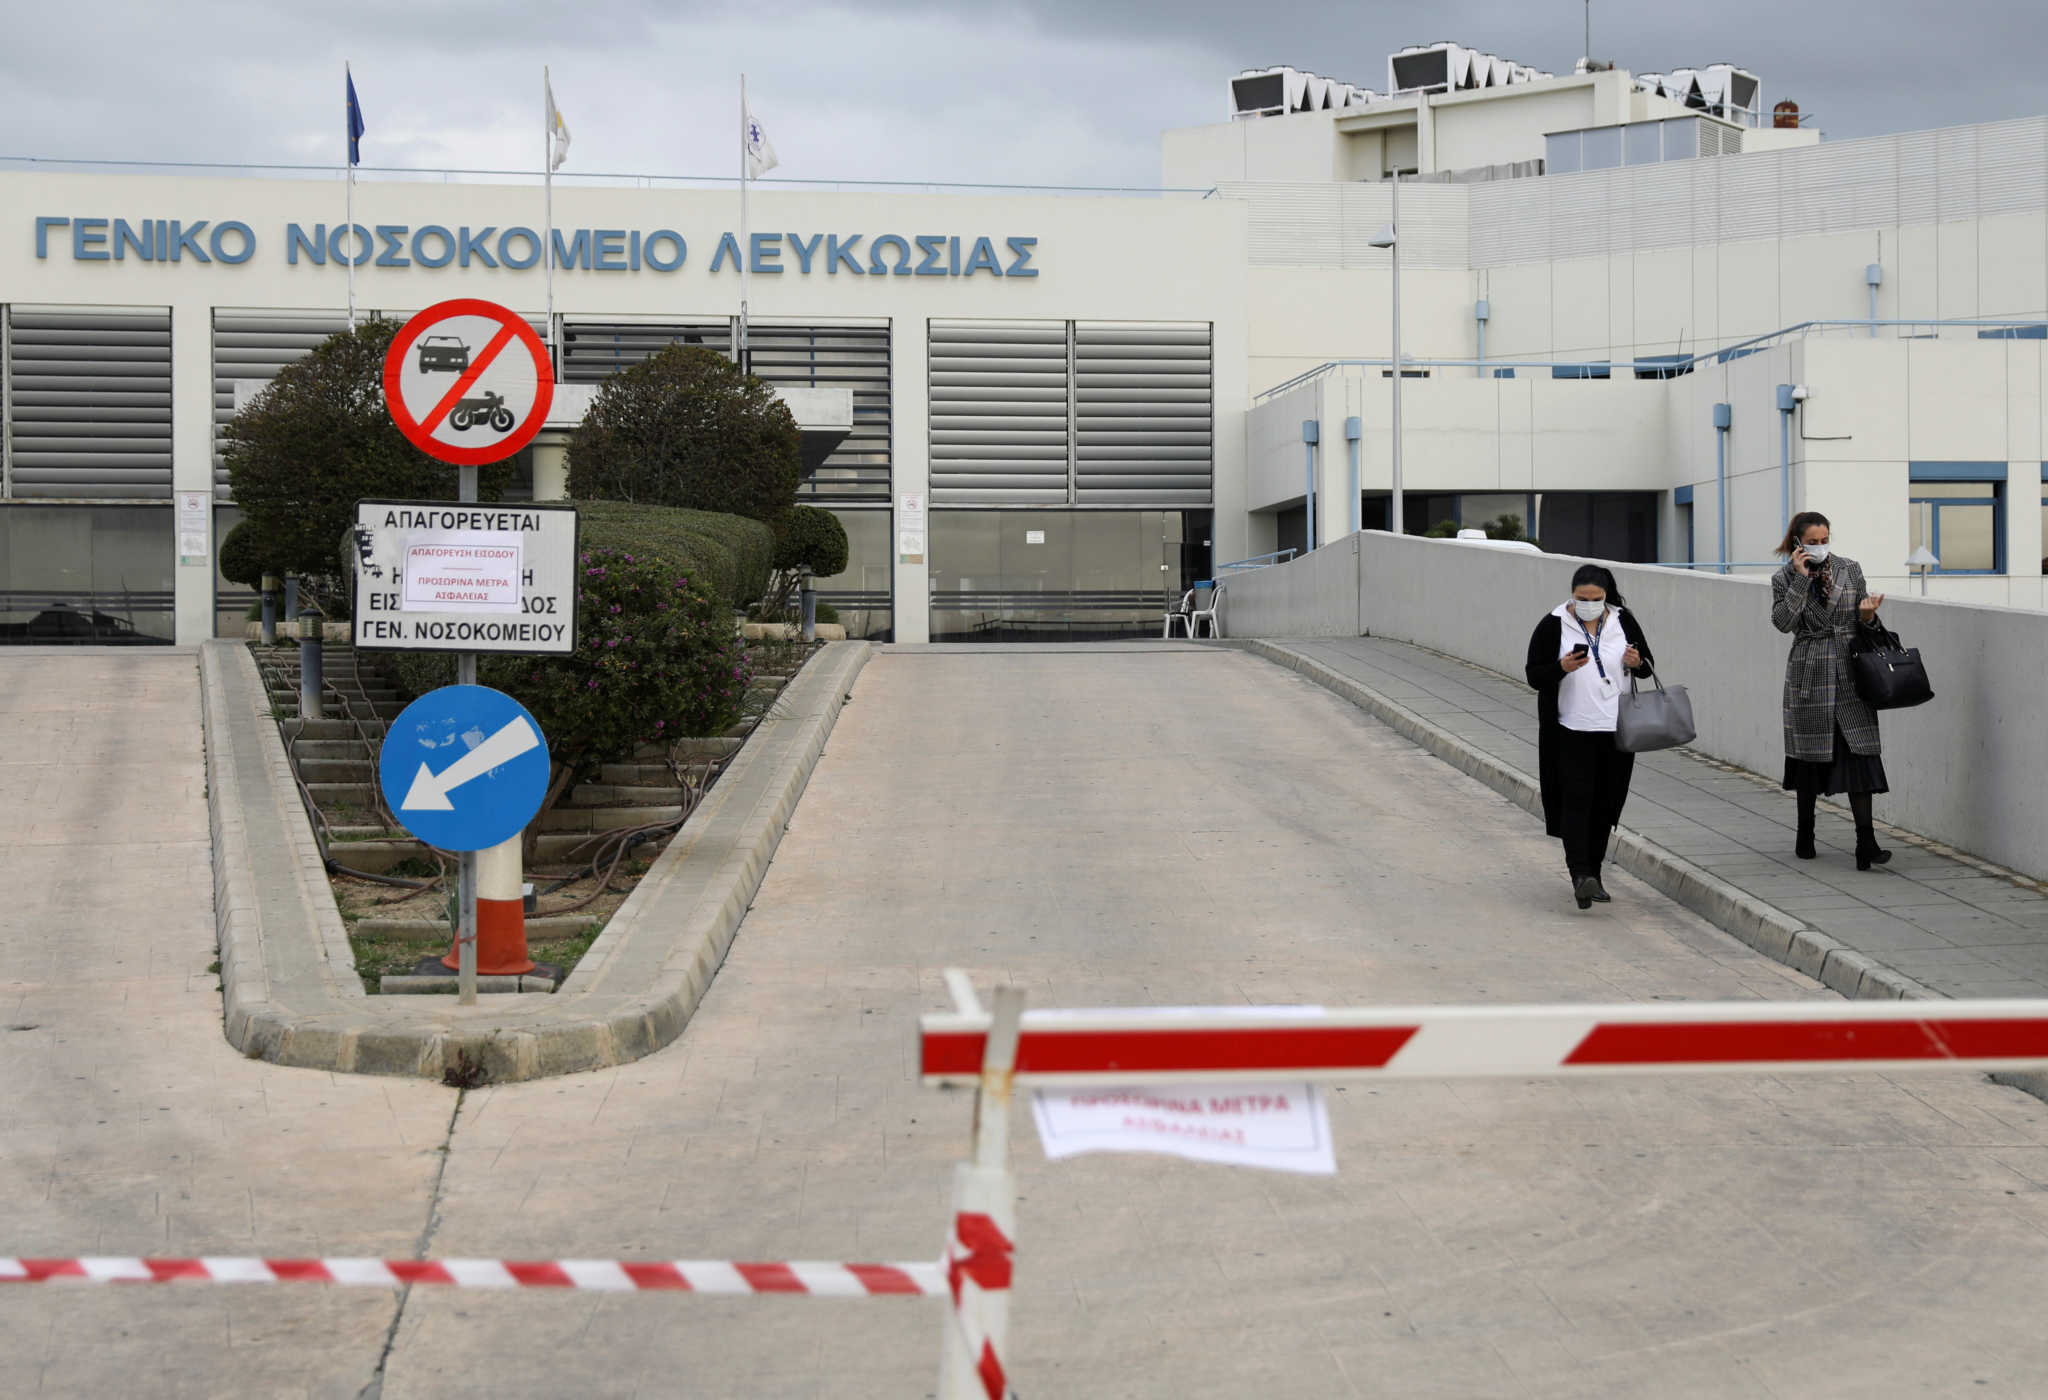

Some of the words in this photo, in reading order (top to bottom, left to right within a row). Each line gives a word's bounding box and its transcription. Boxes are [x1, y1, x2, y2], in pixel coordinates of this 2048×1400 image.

[35, 216, 257, 265] ΓΕΝΙΚΟ
[287, 222, 688, 273] ΝΟΣΟΚΟΜΕΙΟ
[708, 230, 1040, 277] ΛΕΥΚΩΣΙΑΣ
[384, 510, 541, 532] ΑΠΑΓΟΡΕΥΕΤΑΙ
[410, 547, 472, 558] ΑΠΑΓΟΡΕΥΣΗ
[474, 549, 515, 559] ΕΙΣΟΔΟΥ
[418, 576, 474, 587] ΠΡΟΣΩΡΙΝΑ
[475, 578, 509, 588] ΜΕΤΡΑ
[434, 591, 489, 601] ΑΣΦΑΛΕΙΑΣ
[362, 620, 408, 640] ΓΕΝ.
[415, 621, 566, 642] ΝΟΣΟΚΟΜΕΙΟΥ
